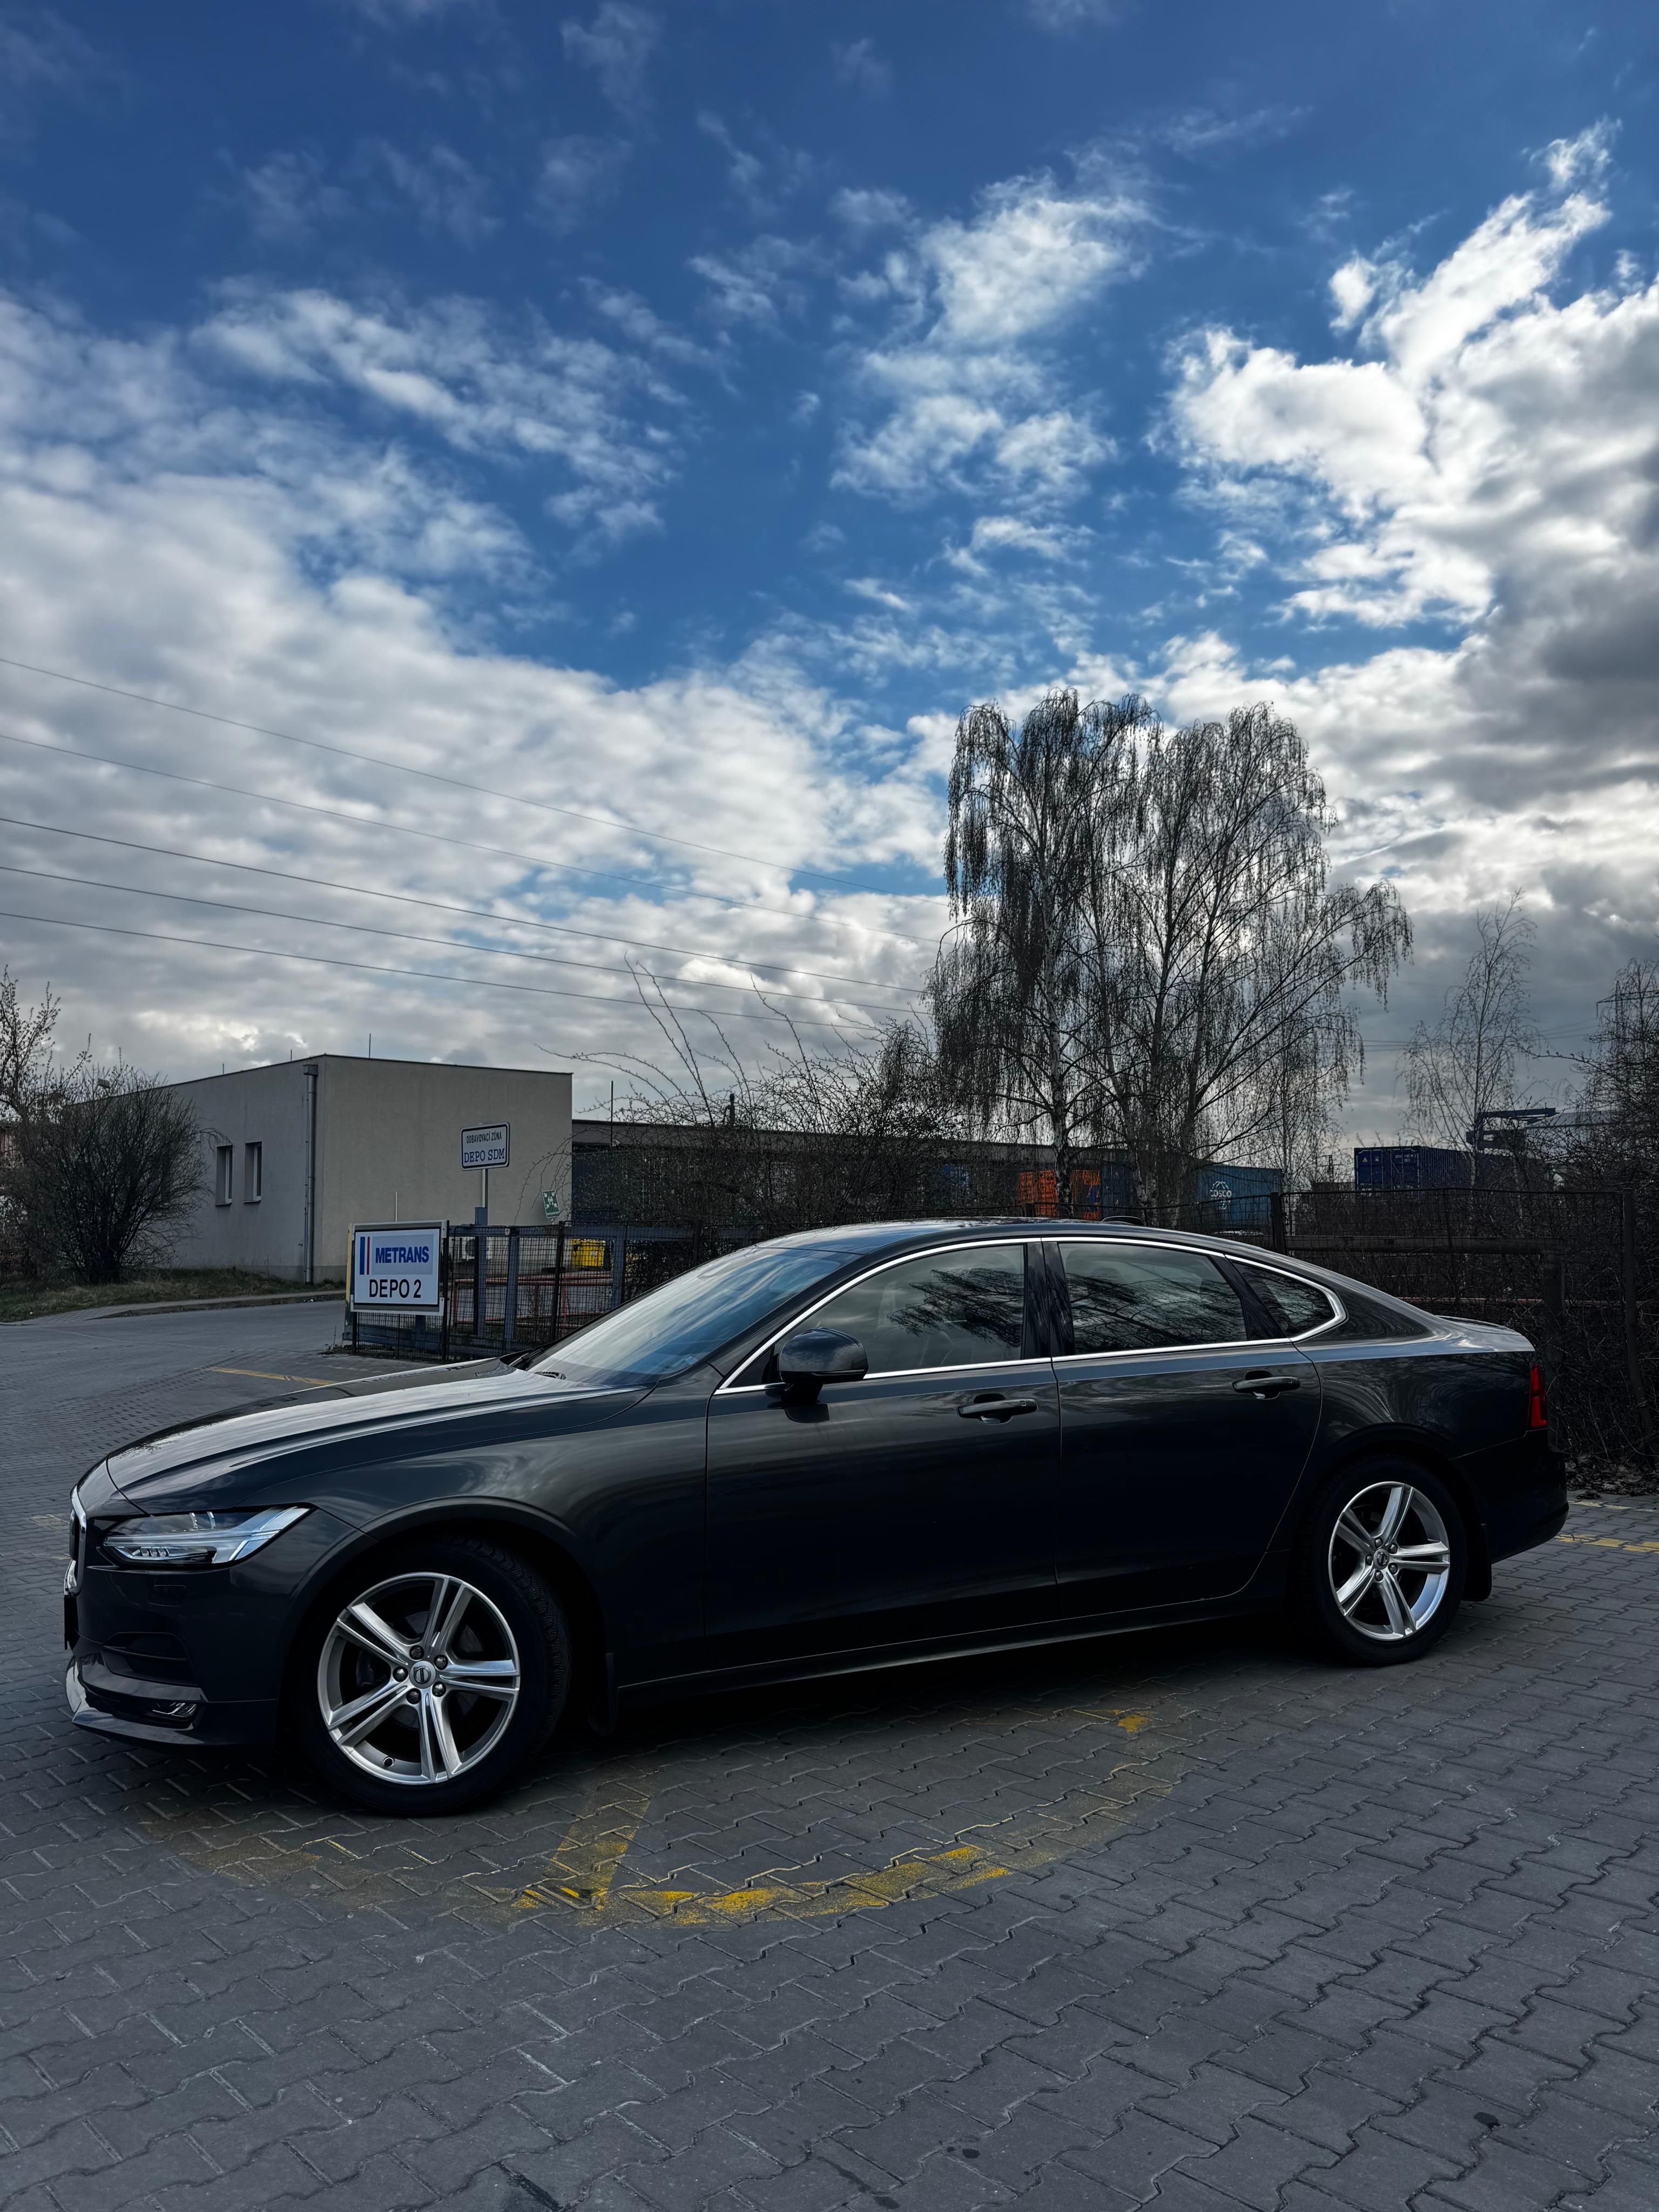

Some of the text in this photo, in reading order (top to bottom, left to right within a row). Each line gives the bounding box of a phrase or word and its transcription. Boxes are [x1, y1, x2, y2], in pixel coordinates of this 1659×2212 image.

[466, 1130, 502, 1144] ODBAVOVACÍ ZÓNA
[464, 1148, 505, 1163] DEPO SDM
[375, 1246, 429, 1263] METRANS
[369, 1279, 421, 1298] DEPO 2
